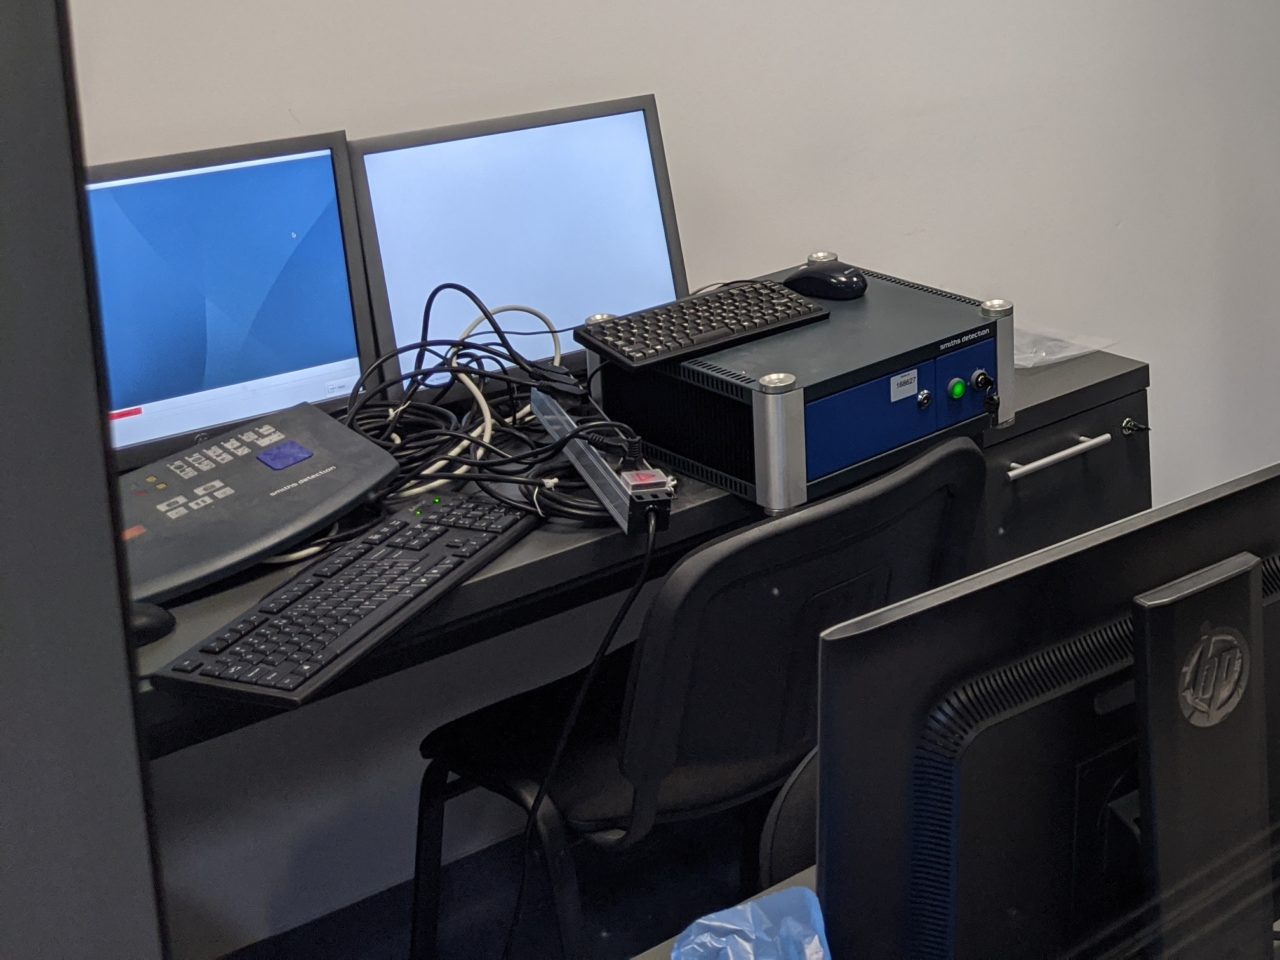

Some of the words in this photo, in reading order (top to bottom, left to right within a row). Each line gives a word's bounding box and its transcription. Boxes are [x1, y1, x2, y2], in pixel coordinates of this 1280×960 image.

[939, 338, 961, 351] smiths
[961, 328, 990, 343] detection
[299, 465, 337, 485] detection
